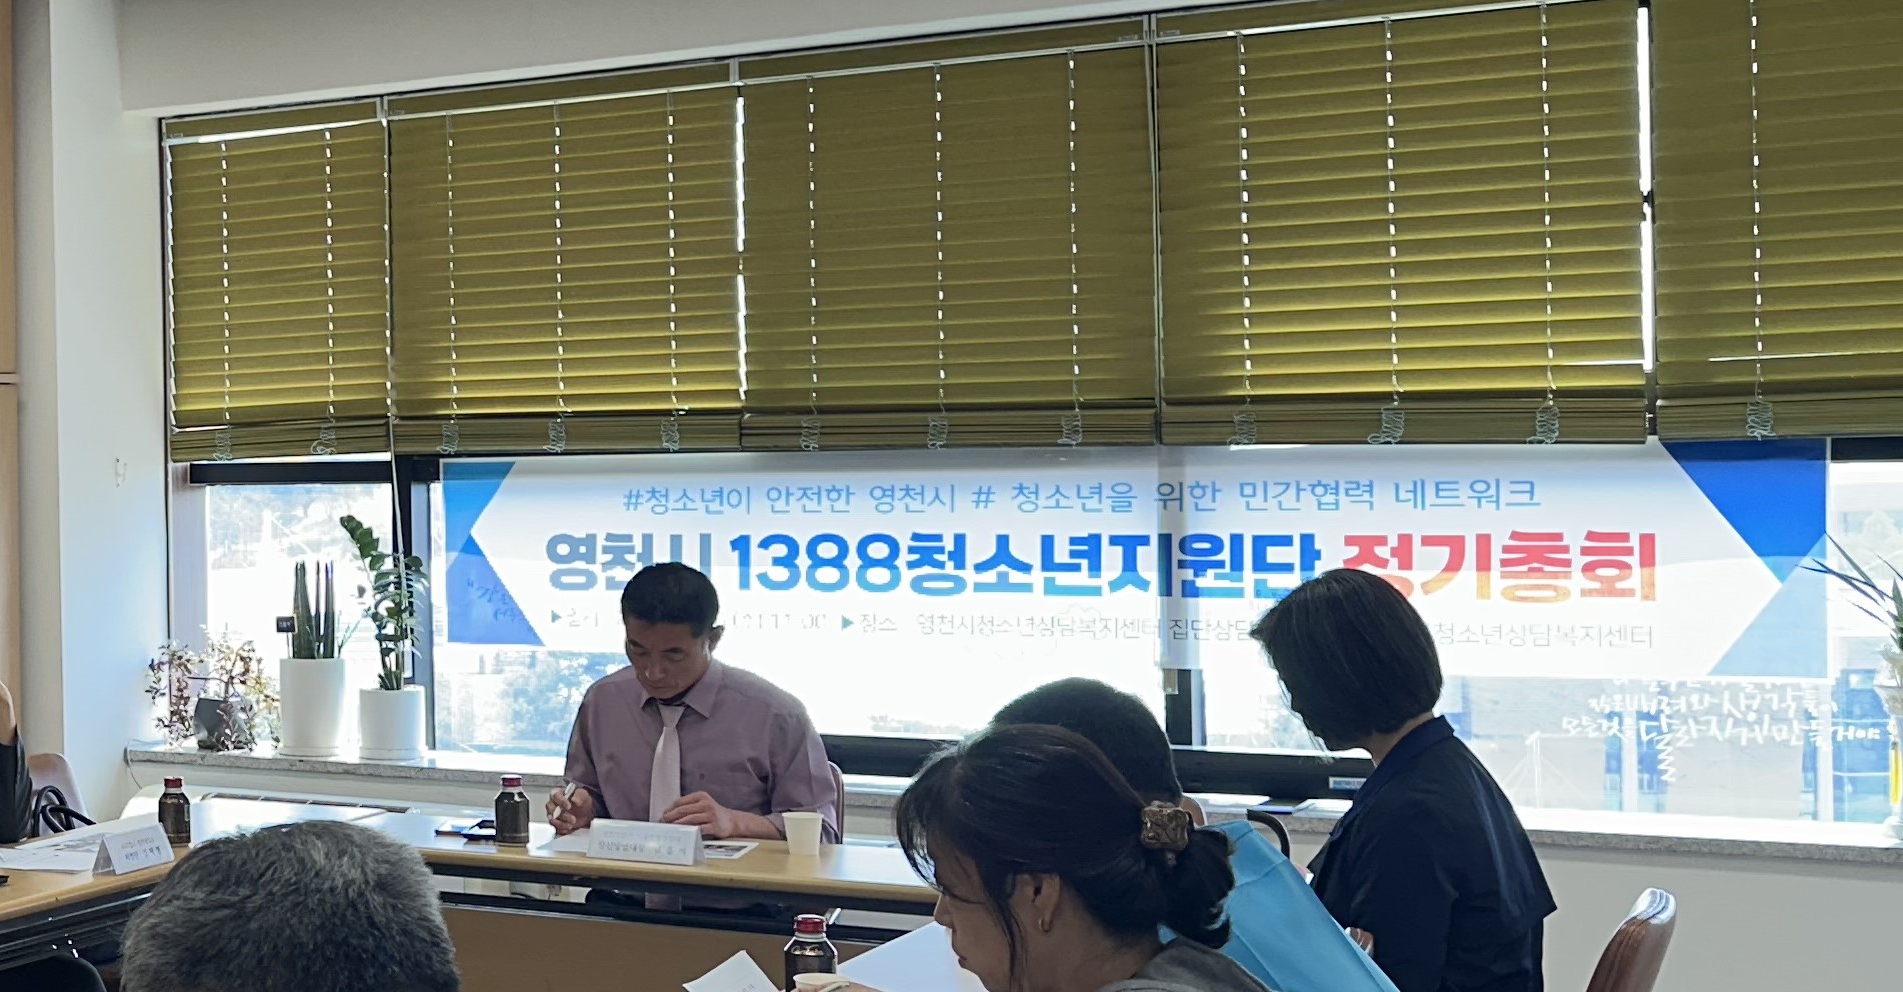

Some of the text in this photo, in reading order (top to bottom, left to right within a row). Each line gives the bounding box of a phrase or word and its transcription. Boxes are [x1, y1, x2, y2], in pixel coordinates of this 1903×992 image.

[623, 478, 1541, 516] #청소년이 안전한 영천시 # 청소년을 위한 민간협력 네트워크
[729, 531, 1322, 600] 1388청소년지원단
[1342, 530, 1657, 603] 정기총회
[1434, 621, 1654, 650] 청소년상담복지센터
